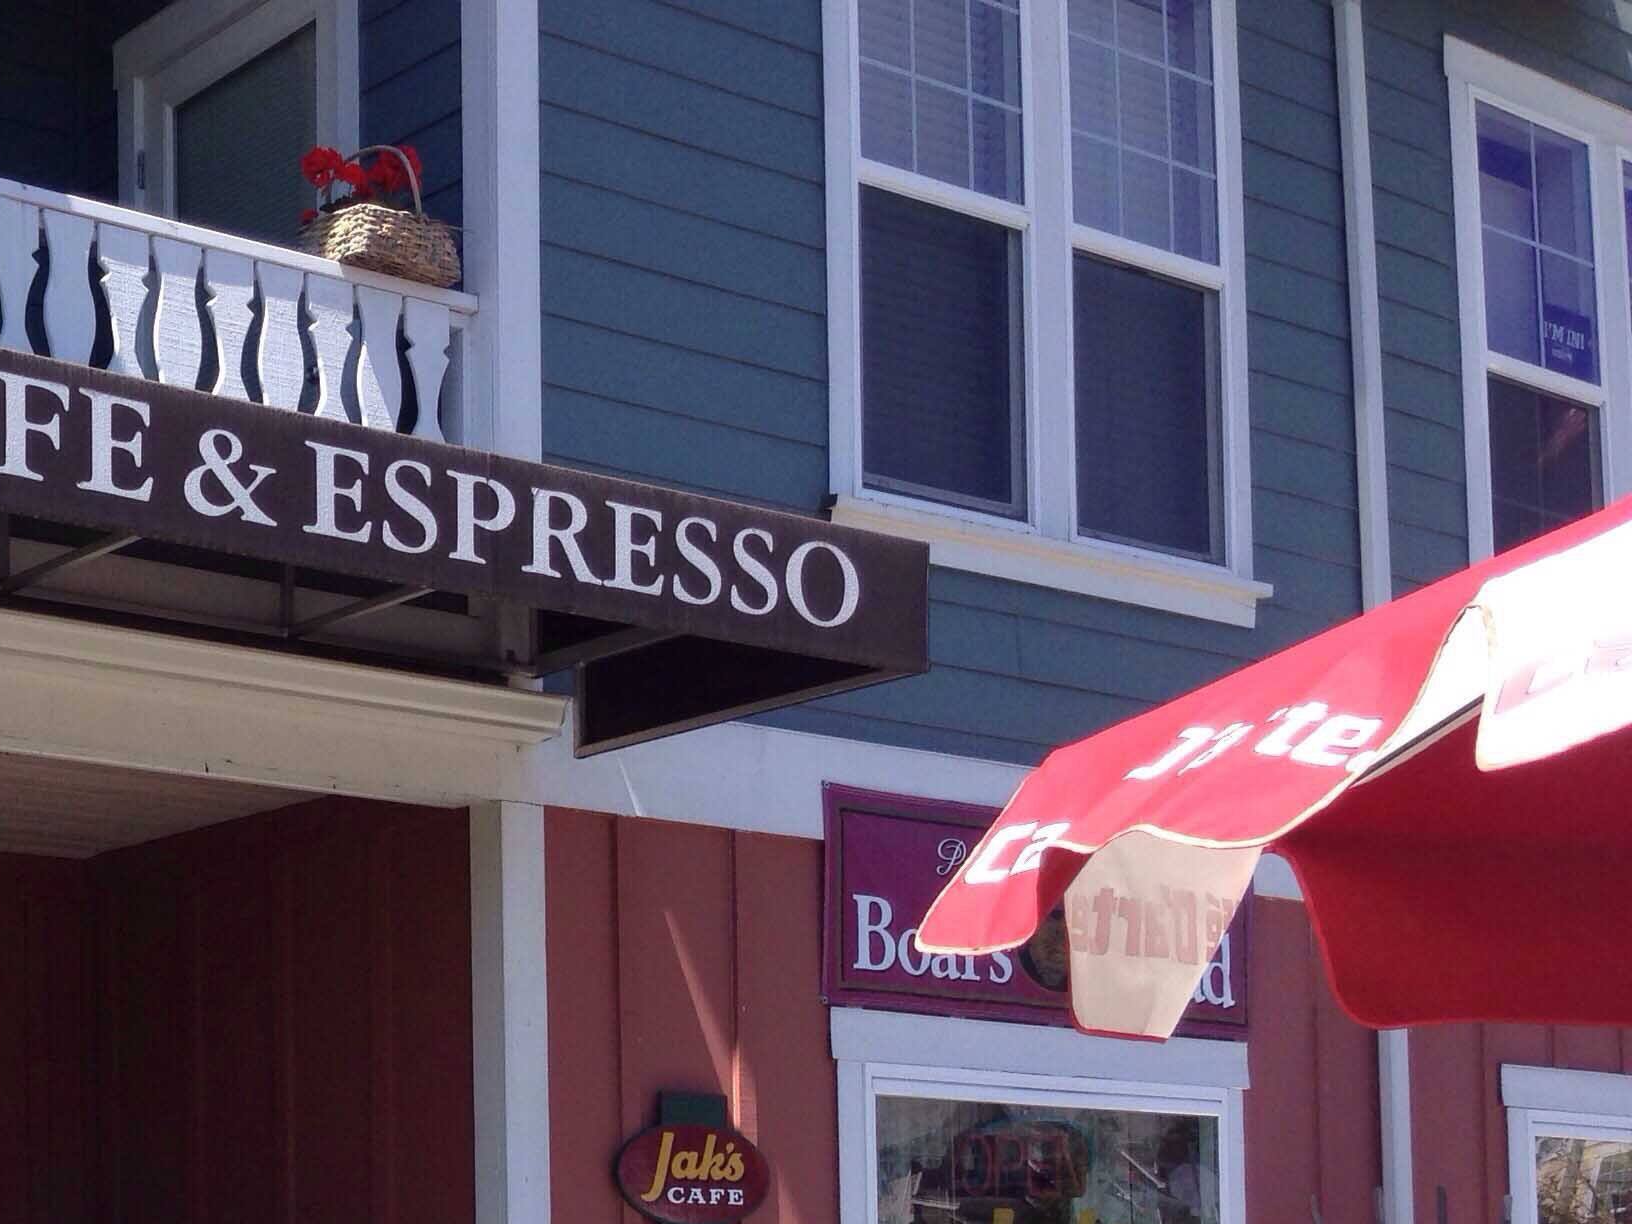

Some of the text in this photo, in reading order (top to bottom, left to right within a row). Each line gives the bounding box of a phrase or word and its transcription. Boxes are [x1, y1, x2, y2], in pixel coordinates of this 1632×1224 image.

[183, 428, 278, 527] &
[301, 439, 861, 629] ESPRESSO
[640, 1131, 745, 1202] Jak's
[666, 1186, 744, 1206] CAFE
